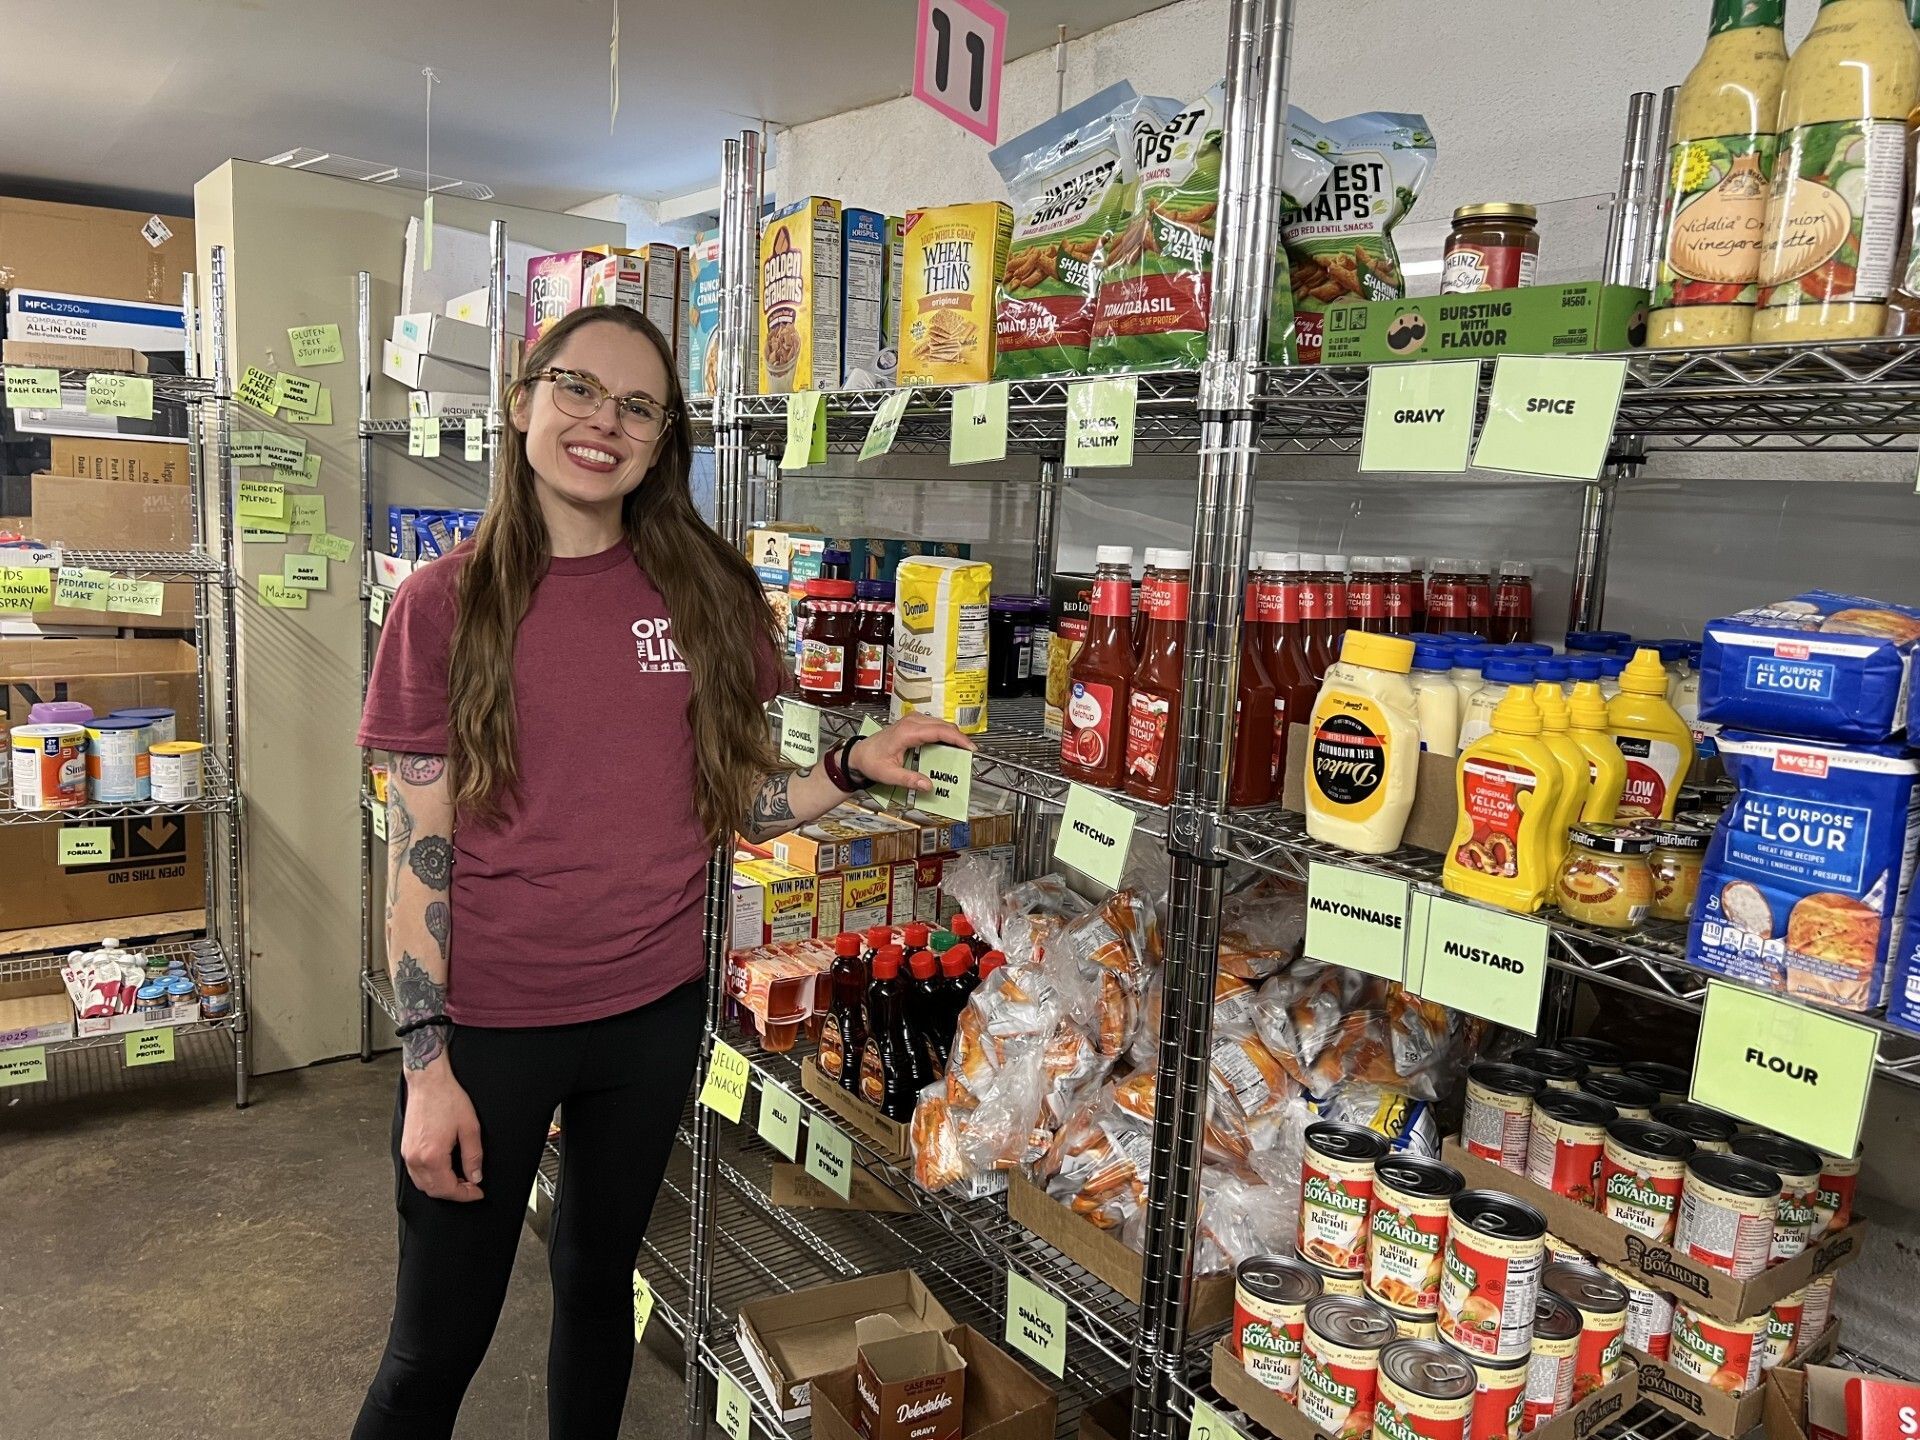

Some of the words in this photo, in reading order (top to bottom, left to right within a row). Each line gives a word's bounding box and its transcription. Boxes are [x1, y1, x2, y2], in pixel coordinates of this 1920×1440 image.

[932, 7, 985, 112] 11
[858, 222, 874, 232] RICE
[1301, 226, 1315, 235] RED
[1317, 225, 1342, 234] LENTIL
[1344, 221, 1374, 231] SNACKS
[852, 229, 880, 241] KRISPIES
[935, 230, 956, 241] WHOLE
[957, 230, 976, 241] GRAIN
[922, 241, 973, 266] WHEAT
[1172, 243, 1203, 262] SIZE
[532, 276, 571, 302] Raisin
[1363, 272, 1399, 299] SHARING
[932, 296, 960, 307] original
[1135, 298, 1176, 313] BASIL
[534, 299, 566, 326] Bran
[1440, 302, 1512, 321] BURSTING
[26, 316, 67, 327] COMPACT
[69, 320, 98, 329] LASER
[27, 323, 87, 336] ALL-IN-ONE
[996, 317, 1026, 333] OMATO
[1460, 318, 1489, 331] WITH
[291, 327, 325, 341] GLUTEN
[1441, 328, 1507, 348] FLAVOR
[302, 337, 321, 347] FREE
[298, 344, 337, 358] STUFFING
[8, 377, 38, 386] DIAPER
[94, 376, 127, 388] KIDS
[248, 368, 277, 387] GLUTE
[248, 377, 270, 393] FREE
[286, 378, 310, 389] GLUTEN
[7, 387, 30, 395] RASH
[90, 387, 117, 397] BODY
[240, 383, 273, 404] PANCAK
[283, 393, 308, 403] SNACKS
[289, 386, 304, 395] FREE
[95, 399, 127, 408] WASH
[244, 396, 264, 410] MIX
[1526, 398, 1576, 415] SPICE
[972, 415, 987, 426] TEA
[1394, 409, 1445, 424] GRAVY
[1077, 434, 1119, 449] HEALTHY
[264, 445, 289, 454] GLUTEN
[289, 449, 303, 458] FREE
[271, 462, 293, 470] CHEESE
[284, 456, 297, 464] AND
[241, 483, 283, 493] CHILDRENS
[240, 494, 277, 505] TYLENOL
[61, 568, 83, 578] KIDS
[58, 577, 105, 590] PEDIATRIC
[108, 582, 138, 593] KIDS
[60, 588, 94, 601] SHAKE
[107, 594, 160, 605] OOTHPASTE
[265, 584, 302, 600] Matzos
[903, 600, 929, 617] Domino
[1063, 601, 1077, 611] RED
[636, 640, 647, 658] THE
[645, 638, 684, 661] LIN
[898, 633, 933, 657] Golden
[1757, 663, 1775, 672] ALL
[1779, 665, 1824, 678] PURPOSE
[1756, 672, 1822, 692] FLOUR
[1072, 708, 1096, 722] Ketchup
[1130, 715, 1156, 732] TOMATO
[788, 728, 813, 744] COOKIES,
[1318, 742, 1355, 759] MAYONNAISE
[1356, 746, 1374, 760] REAL
[1778, 752, 1827, 770] weis
[929, 769, 959, 785] BAKING
[1316, 756, 1378, 787] Duke's
[935, 787, 950, 799] MIX
[1475, 787, 1511, 801] ORIGINAL
[1470, 793, 1516, 812] YELLOW
[1472, 805, 1509, 819] MUSTARD
[1744, 799, 1772, 816] ALL
[1777, 807, 1854, 829] PURPOSE
[1073, 820, 1116, 848] KETCHUP
[1743, 814, 1848, 852] FLOUR
[1758, 844, 1778, 854] GREAT
[1779, 848, 1793, 858] FOR
[1795, 852, 1825, 864] RECIPES
[159, 866, 185, 880] OPEN
[1733, 850, 1764, 865] BLEACHED
[1770, 859, 1804, 873] ENRICHED
[1812, 869, 1852, 883] PRESIFTED
[108, 872, 129, 884] END
[132, 867, 156, 882] THIS
[846, 871, 862, 882] TWIN
[863, 868, 877, 879] PACK
[771, 882, 792, 895] TWIN
[794, 878, 815, 891] PACK
[1310, 896, 1402, 929] MAYONNAISE
[1444, 941, 1525, 974] MUSTARD
[0, 1030, 28, 1043] 2025
[140, 1034, 159, 1043] BABY
[136, 1049, 165, 1059] PROTEIN
[139, 1043, 161, 1051] FOOD,
[19, 1059, 42, 1067] FOOD,
[713, 1050, 745, 1077] JELLO
[1745, 1047, 1819, 1086] FLOUR
[10, 1068, 31, 1077] FRUIT
[708, 1071, 744, 1100] SNACKS
[772, 1108, 788, 1125] JELLO
[815, 1143, 844, 1169] PANCAKE
[818, 1159, 839, 1178] SYRUP
[1304, 1184, 1368, 1214] BOYARDEE
[1607, 1180, 1675, 1211] BOYARDEE
[1310, 1211, 1348, 1232] Ravioli
[1615, 1207, 1655, 1228] Ravioli
[1373, 1216, 1439, 1249] BOYARDEE
[1388, 1242, 1408, 1256] Mini
[1379, 1245, 1418, 1270] Ravioli
[1643, 1255, 1710, 1295] BOYARDEE
[1638, 1289, 1655, 1299] Facts
[1018, 1306, 1054, 1339] SNACKS,
[1022, 1326, 1049, 1349] SALTY
[1252, 1359, 1292, 1376] Ravioli
[1264, 1356, 1282, 1366] Beef
[904, 1383, 922, 1392] CASE
[926, 1377, 946, 1387] PACK
[1638, 1373, 1702, 1411] BOYARDEE
[728, 1400, 740, 1414] CAT
[896, 1392, 953, 1424] Delectables
[725, 1411, 740, 1429] FOOD
[726, 1426, 738, 1439] WET
[910, 1425, 937, 1439] GRAVY
